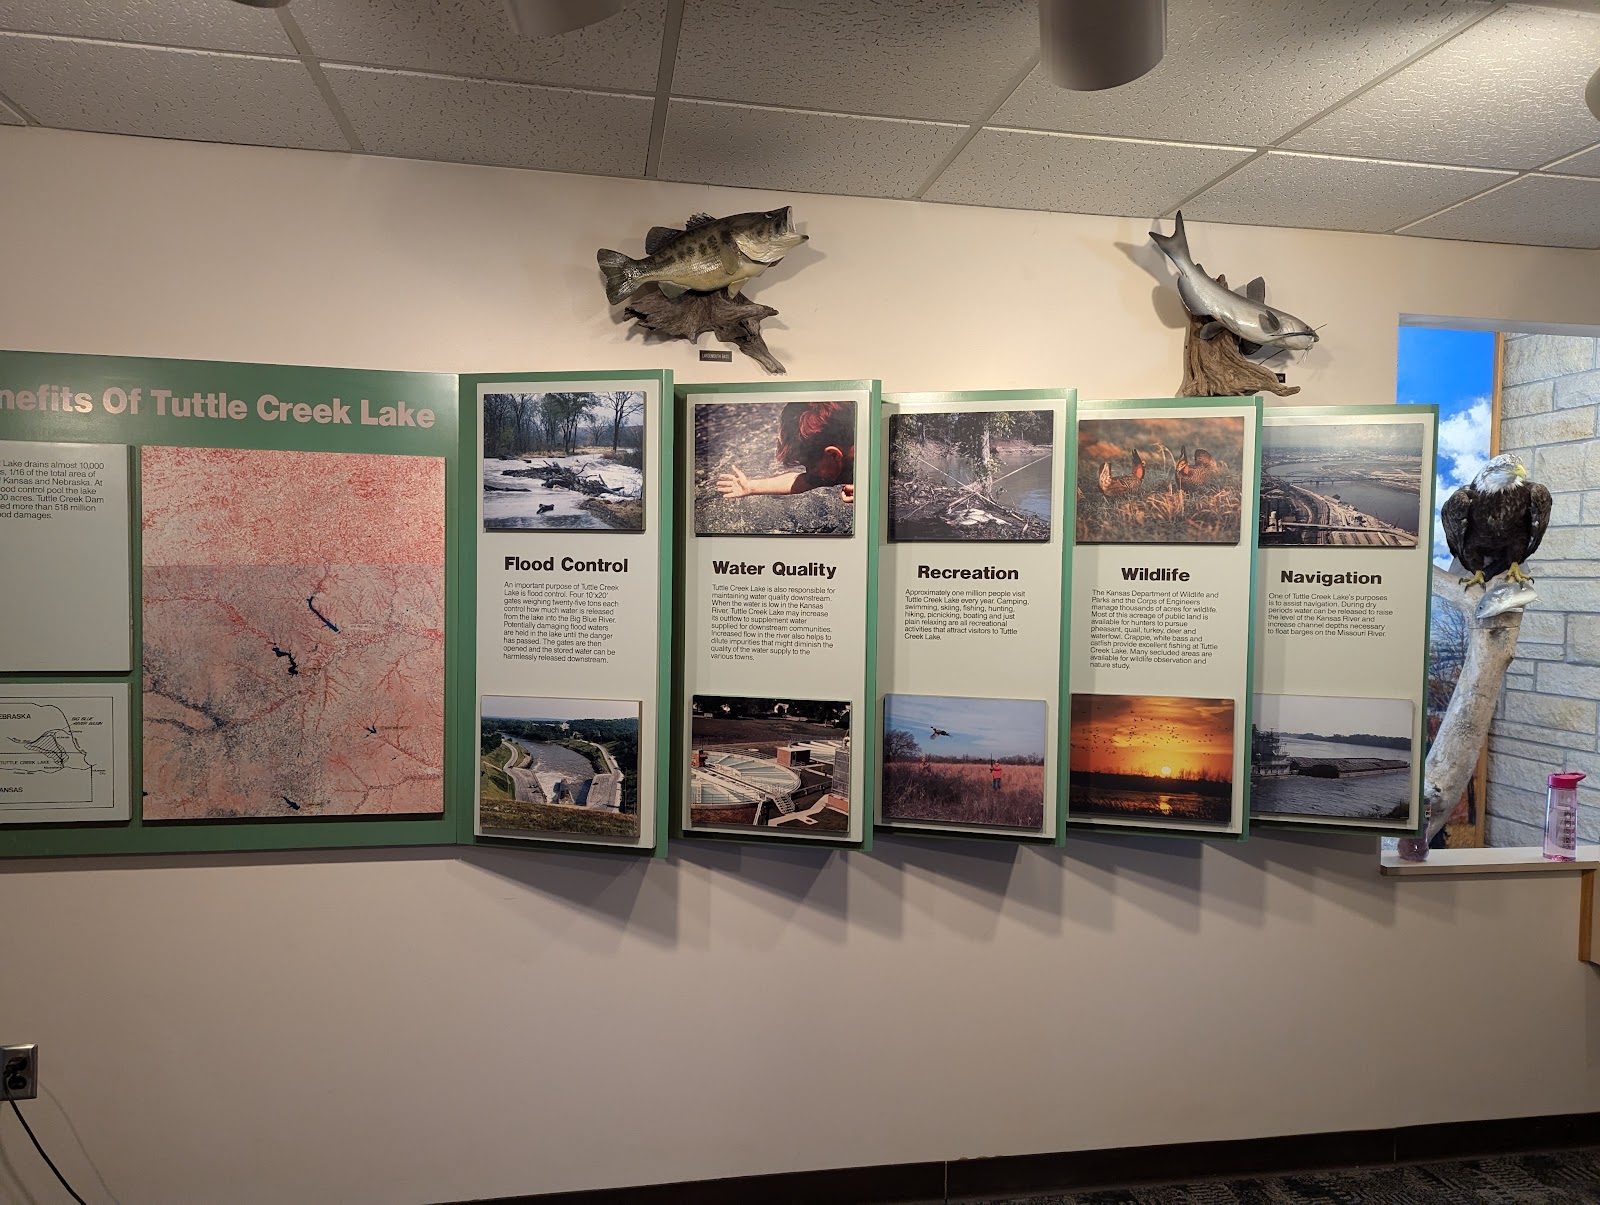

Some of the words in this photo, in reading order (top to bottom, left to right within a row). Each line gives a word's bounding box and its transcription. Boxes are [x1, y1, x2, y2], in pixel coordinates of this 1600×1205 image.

[103, 387, 141, 415] Of
[151, 390, 247, 420] Tuttle
[257, 395, 352, 424] Creek
[361, 400, 436, 429] Lake
[24, 460, 49, 468] drains
[80, 462, 104, 470] 10,000
[35, 477, 50, 485] and
[52, 478, 92, 486] Nebraska.
[18, 485, 45, 493] control
[47, 486, 63, 495] pool
[504, 556, 554, 571] Flood
[561, 557, 628, 573] Control
[713, 560, 765, 575] Water
[772, 561, 837, 579] Quality
[918, 565, 1019, 580] Recreation
[1121, 567, 1190, 582] Wildlife
[1281, 570, 1382, 586] Navigation
[515, 581, 544, 590] important
[546, 583, 572, 591] purpose
[600, 583, 619, 591] Creek
[730, 584, 749, 592] Creek
[774, 585, 787, 593] also
[789, 586, 825, 595] responsible
[528, 589, 543, 597] flood
[712, 591, 748, 601] maintaining
[750, 592, 767, 600] water
[768, 593, 789, 602] quality
[905, 588, 950, 597] Approximately
[988, 589, 1011, 598] people
[1132, 590, 1170, 598] Department
[1180, 590, 1204, 598] Wildlife
[504, 597, 521, 605] gates
[523, 597, 551, 606] weighing
[553, 598, 586, 607] twenty-five
[1137, 597, 1157, 606] Corps
[1167, 598, 1200, 607] Engineers
[1304, 600, 1339, 609] navigation.
[1342, 600, 1364, 609] During
[1366, 601, 1377, 609] dry
[561, 606, 578, 614] water
[586, 607, 614, 615] released
[905, 603, 939, 612] swimming,
[941, 604, 961, 612] skiing,
[963, 604, 986, 613] fishing,
[1268, 606, 1293, 615] periods
[1338, 607, 1367, 615] released
[963, 612, 987, 620] boating
[1003, 612, 1015, 621] just
